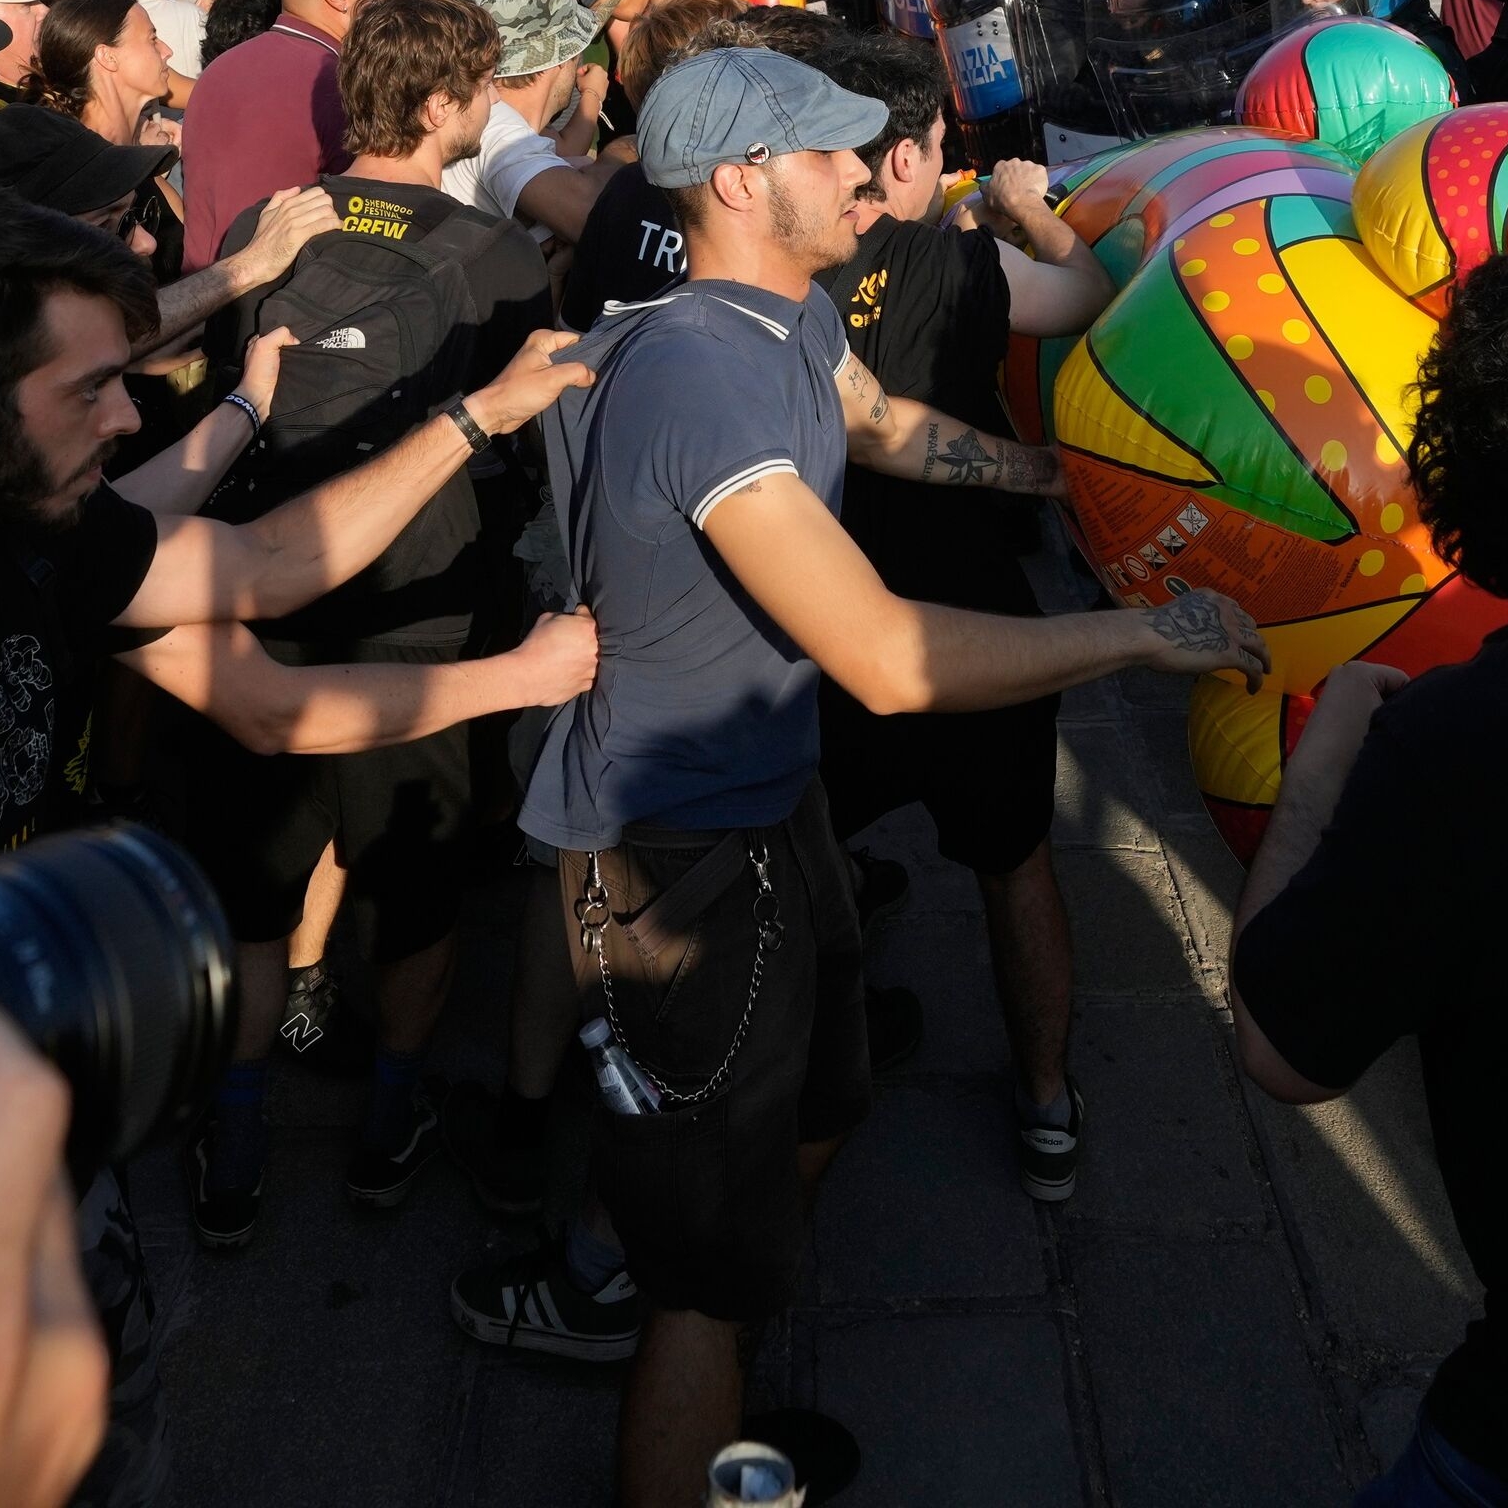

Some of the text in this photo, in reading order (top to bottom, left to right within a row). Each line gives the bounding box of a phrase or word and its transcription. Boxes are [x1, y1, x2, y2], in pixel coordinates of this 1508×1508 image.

[363, 206, 402, 220] FESTIVAL
[364, 198, 414, 216] SHERWOOD
[342, 215, 409, 240] CREW
[638, 220, 688, 274] TR
[330, 328, 349, 337] THE
[322, 341, 349, 349] FACE
[1034, 1136, 1064, 1147] adidas
